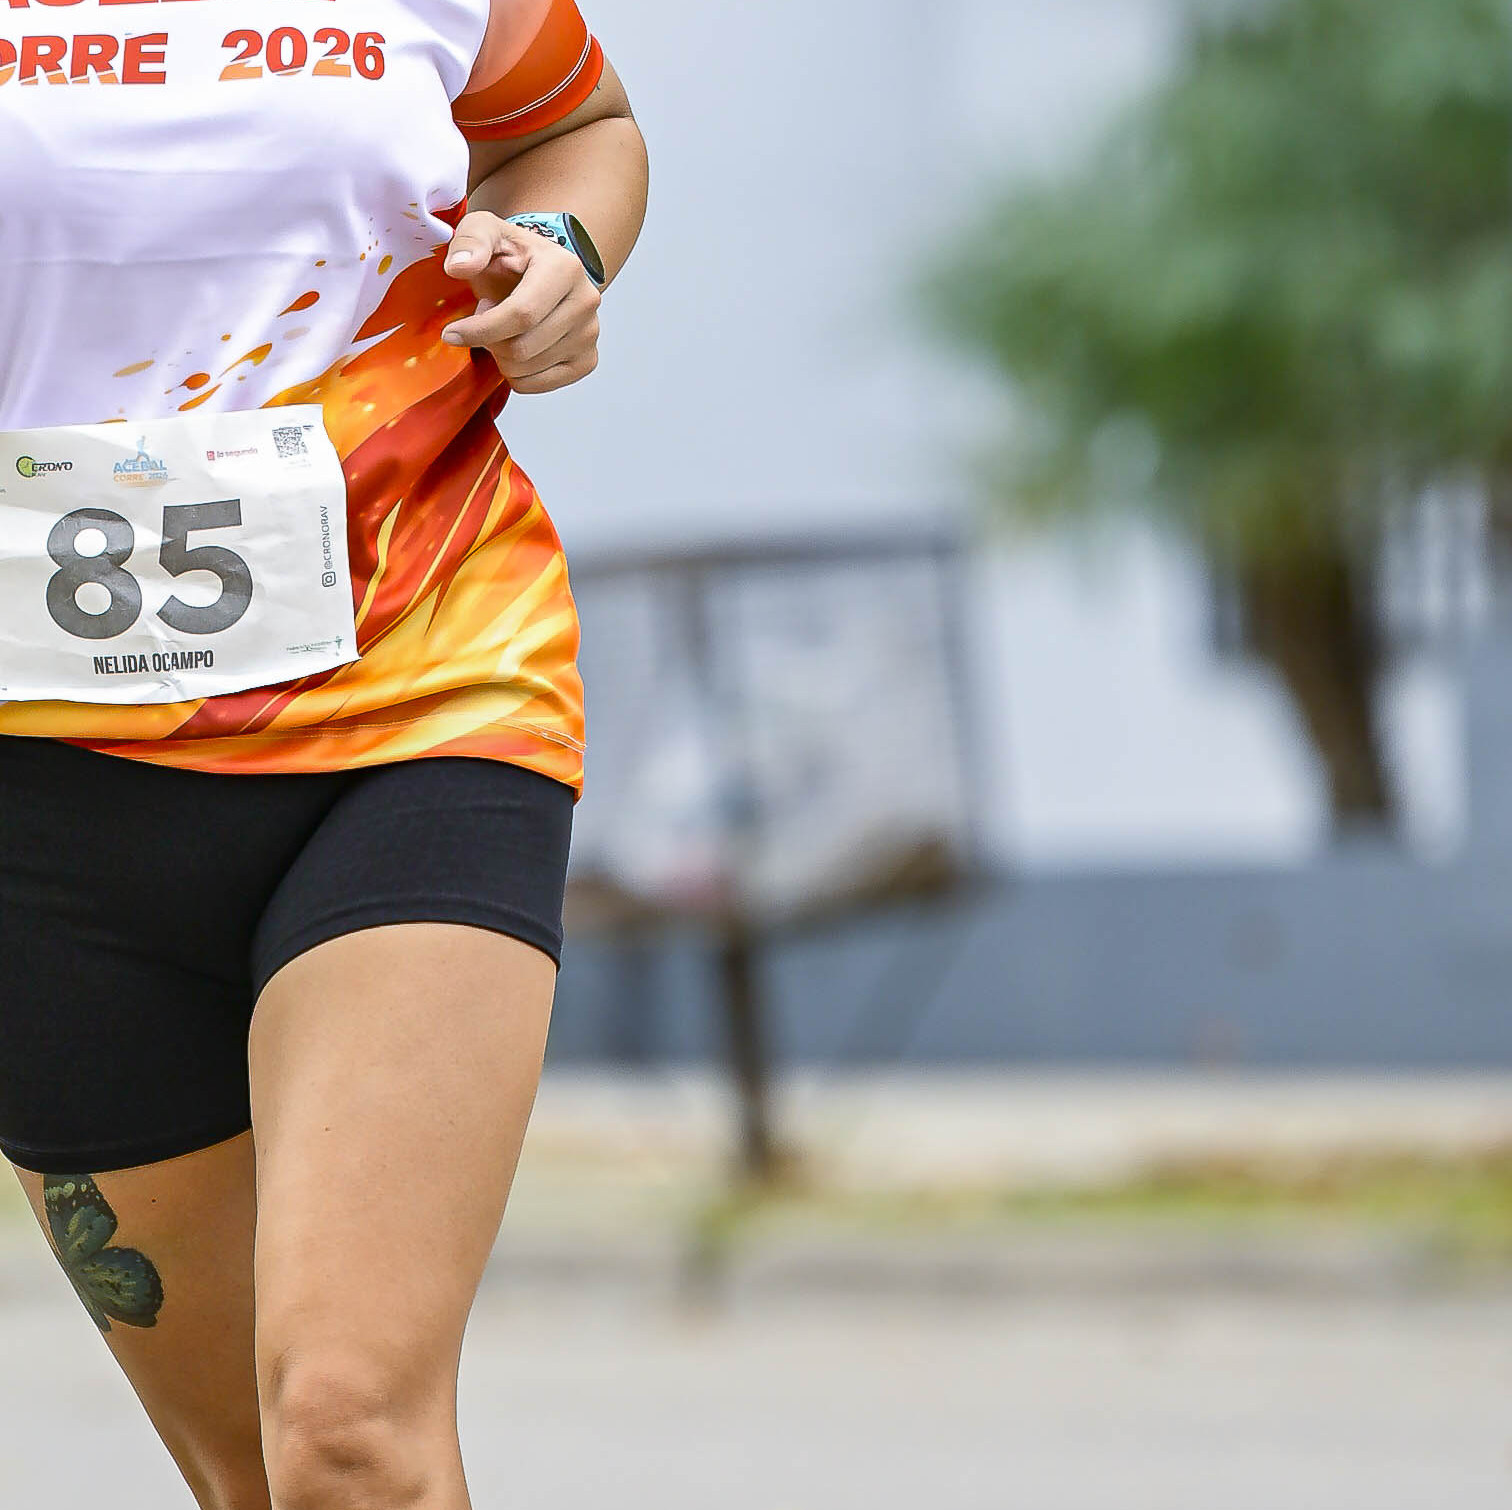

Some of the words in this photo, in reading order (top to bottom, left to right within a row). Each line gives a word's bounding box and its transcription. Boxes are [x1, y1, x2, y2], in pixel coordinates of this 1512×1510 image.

[218, 26, 386, 81] 2026
[319, 505, 333, 570] @CRONORAV
[46, 498, 253, 640] 85
[93, 654, 149, 675] NELIDA
[152, 650, 214, 673] OCAMPO
